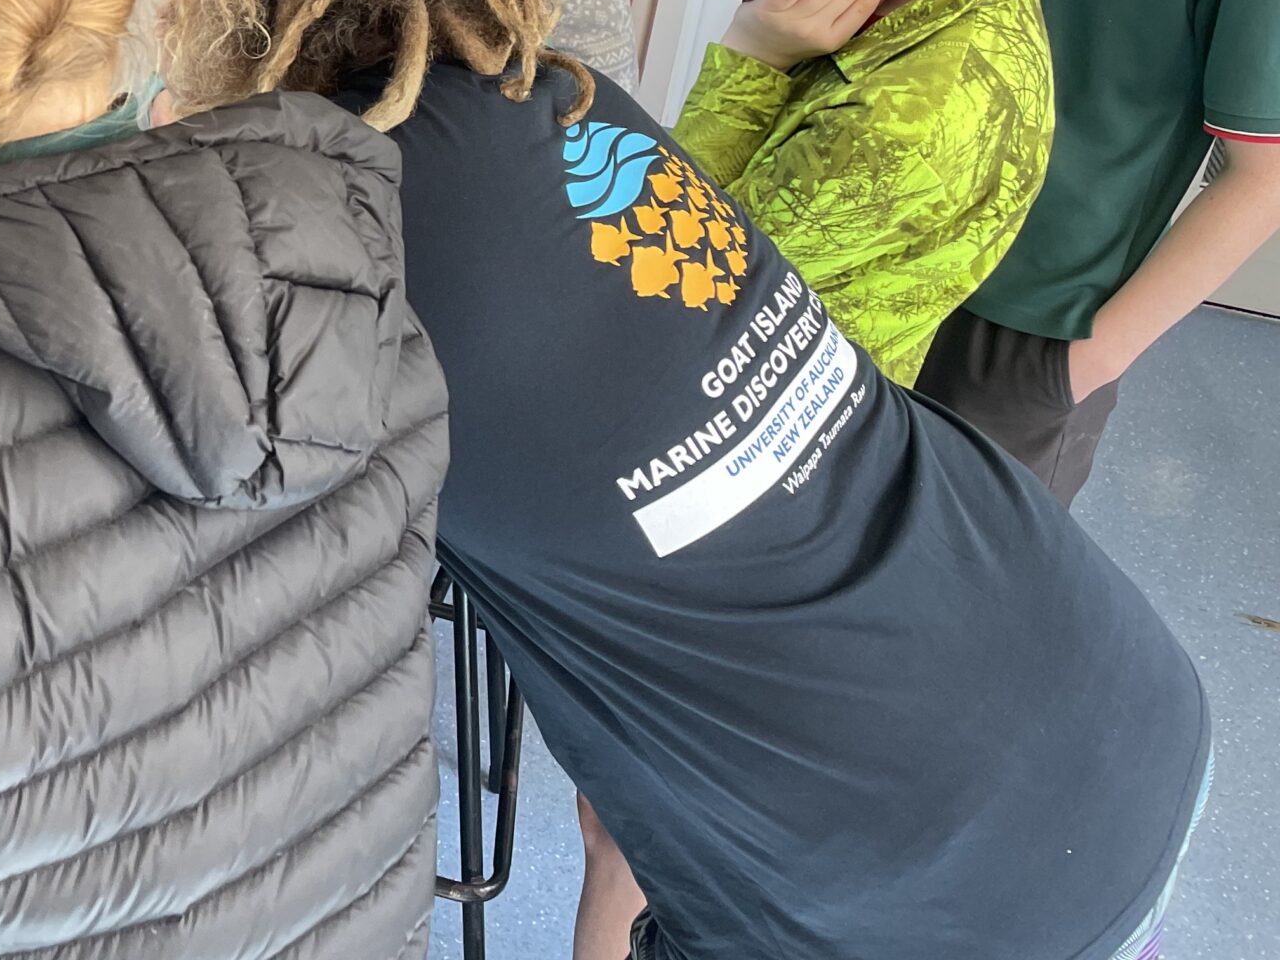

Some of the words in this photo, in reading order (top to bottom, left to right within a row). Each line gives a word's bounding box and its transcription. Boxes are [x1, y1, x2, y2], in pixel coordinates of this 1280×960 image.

[701, 331, 756, 399] GOAT
[749, 271, 803, 343] ISLAND
[616, 409, 738, 501] MARINE
[732, 305, 822, 423] DISCOVERY
[725, 397, 797, 478] UNIVERSITY
[794, 377, 811, 402] OF
[773, 423, 801, 463] NEW
[797, 366, 845, 431] ZEALAND
[782, 446, 824, 495] Waipapa
[818, 404, 854, 450] Taumata
[850, 383, 866, 409] Rau
